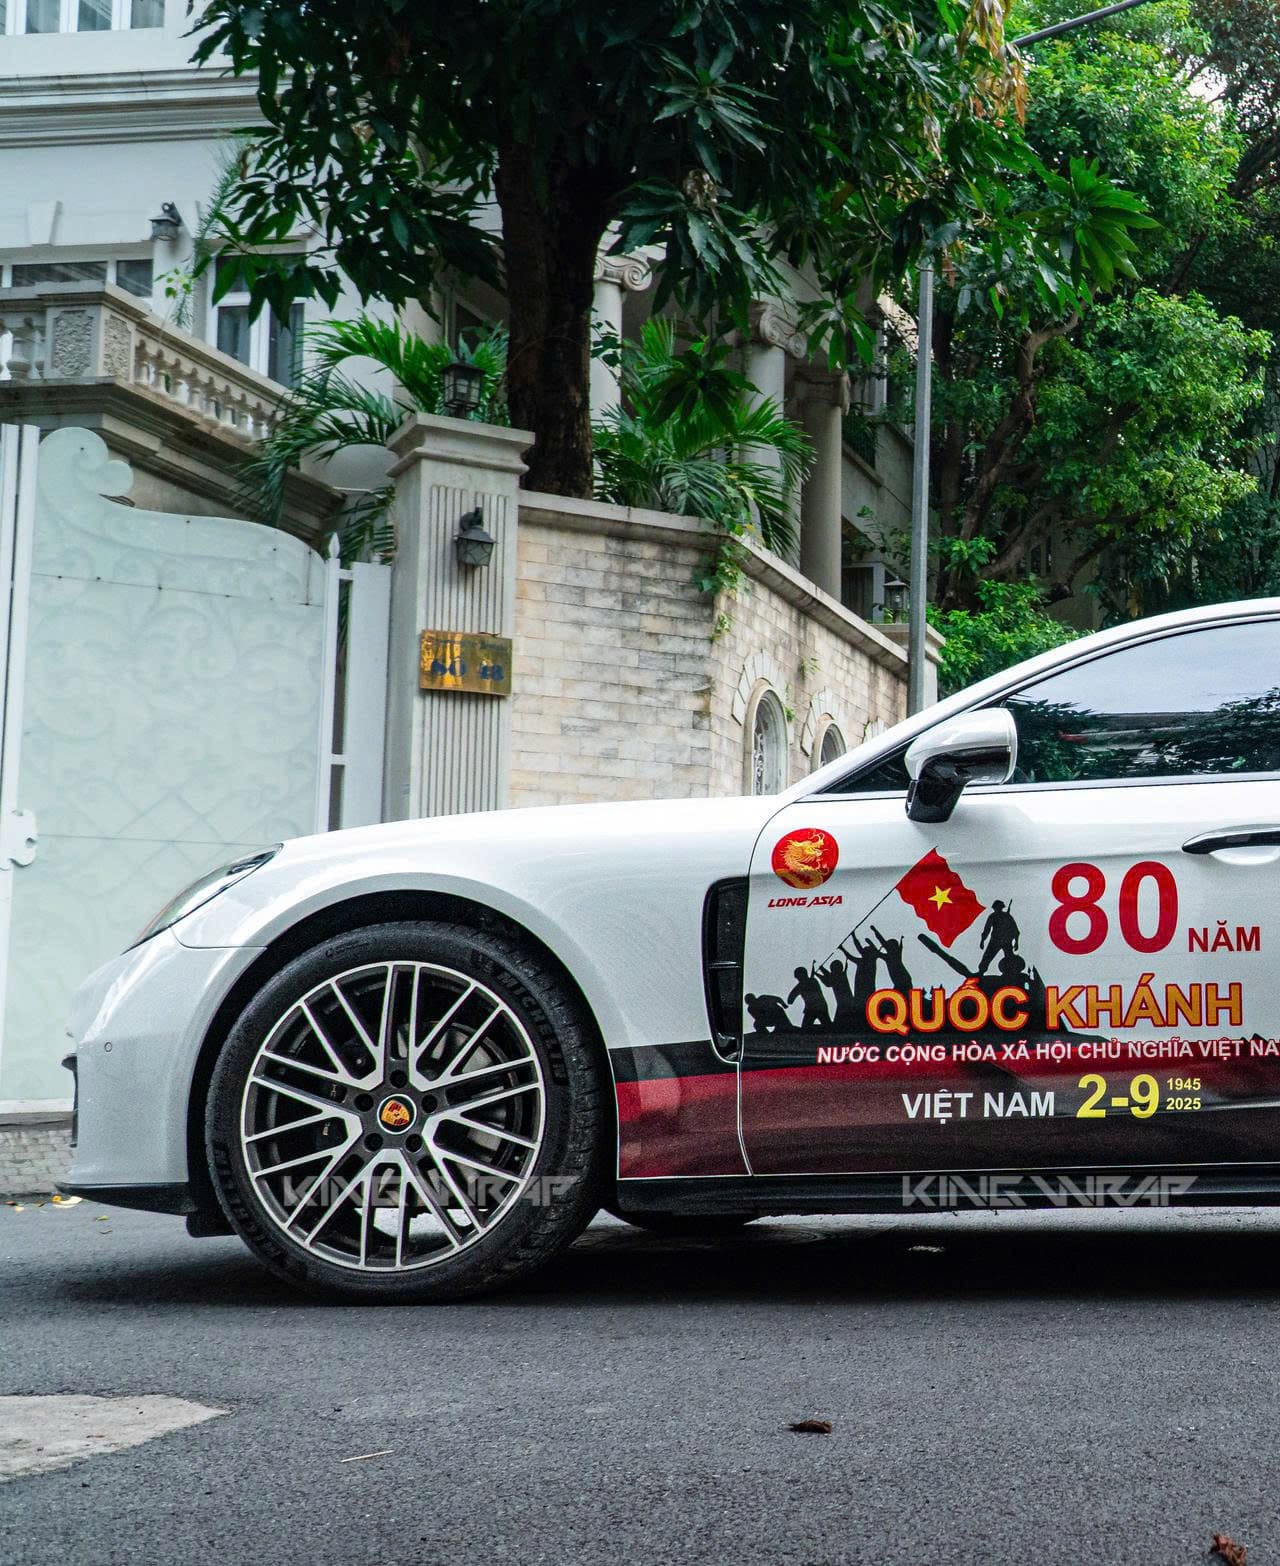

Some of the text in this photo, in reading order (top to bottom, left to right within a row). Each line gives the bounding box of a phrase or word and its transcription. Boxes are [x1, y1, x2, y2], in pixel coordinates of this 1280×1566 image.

[767, 895, 843, 908] LONG ASIA
[1048, 860, 1261, 955] 80 NĂM
[865, 972, 1243, 1037] QUỐC KHÁNH
[816, 1041, 880, 1063] NƯỚC
[886, 1042, 946, 1066] CỘNG
[952, 1040, 995, 1061] HÒA
[1001, 1039, 1031, 1061] XÃ
[1036, 1040, 1072, 1064] HỘI
[1077, 1037, 1121, 1060] CHỦ
[1128, 1037, 1196, 1059] NGHĨA
[1197, 1037, 1244, 1061] VIỆT
[901, 1073, 1160, 1125] VIỆT NAM 2-9
[1166, 1078, 1201, 1091] 1945
[1166, 1097, 1202, 1111] 2025
